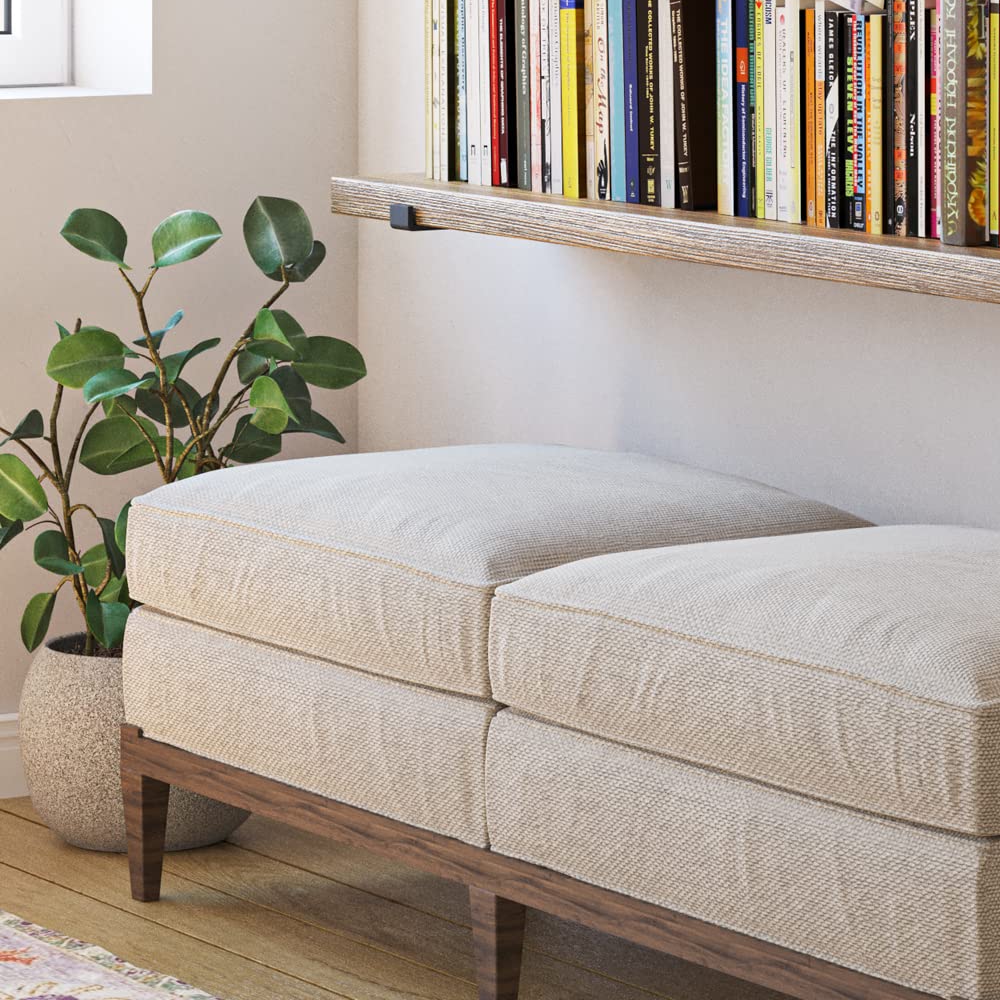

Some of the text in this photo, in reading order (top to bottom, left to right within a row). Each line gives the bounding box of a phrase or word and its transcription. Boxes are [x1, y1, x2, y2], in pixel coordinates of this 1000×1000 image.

[521, 38, 526, 49] of
[649, 82, 653, 92] OF
[857, 100, 863, 113] IN
[845, 159, 853, 196] HACKERS
